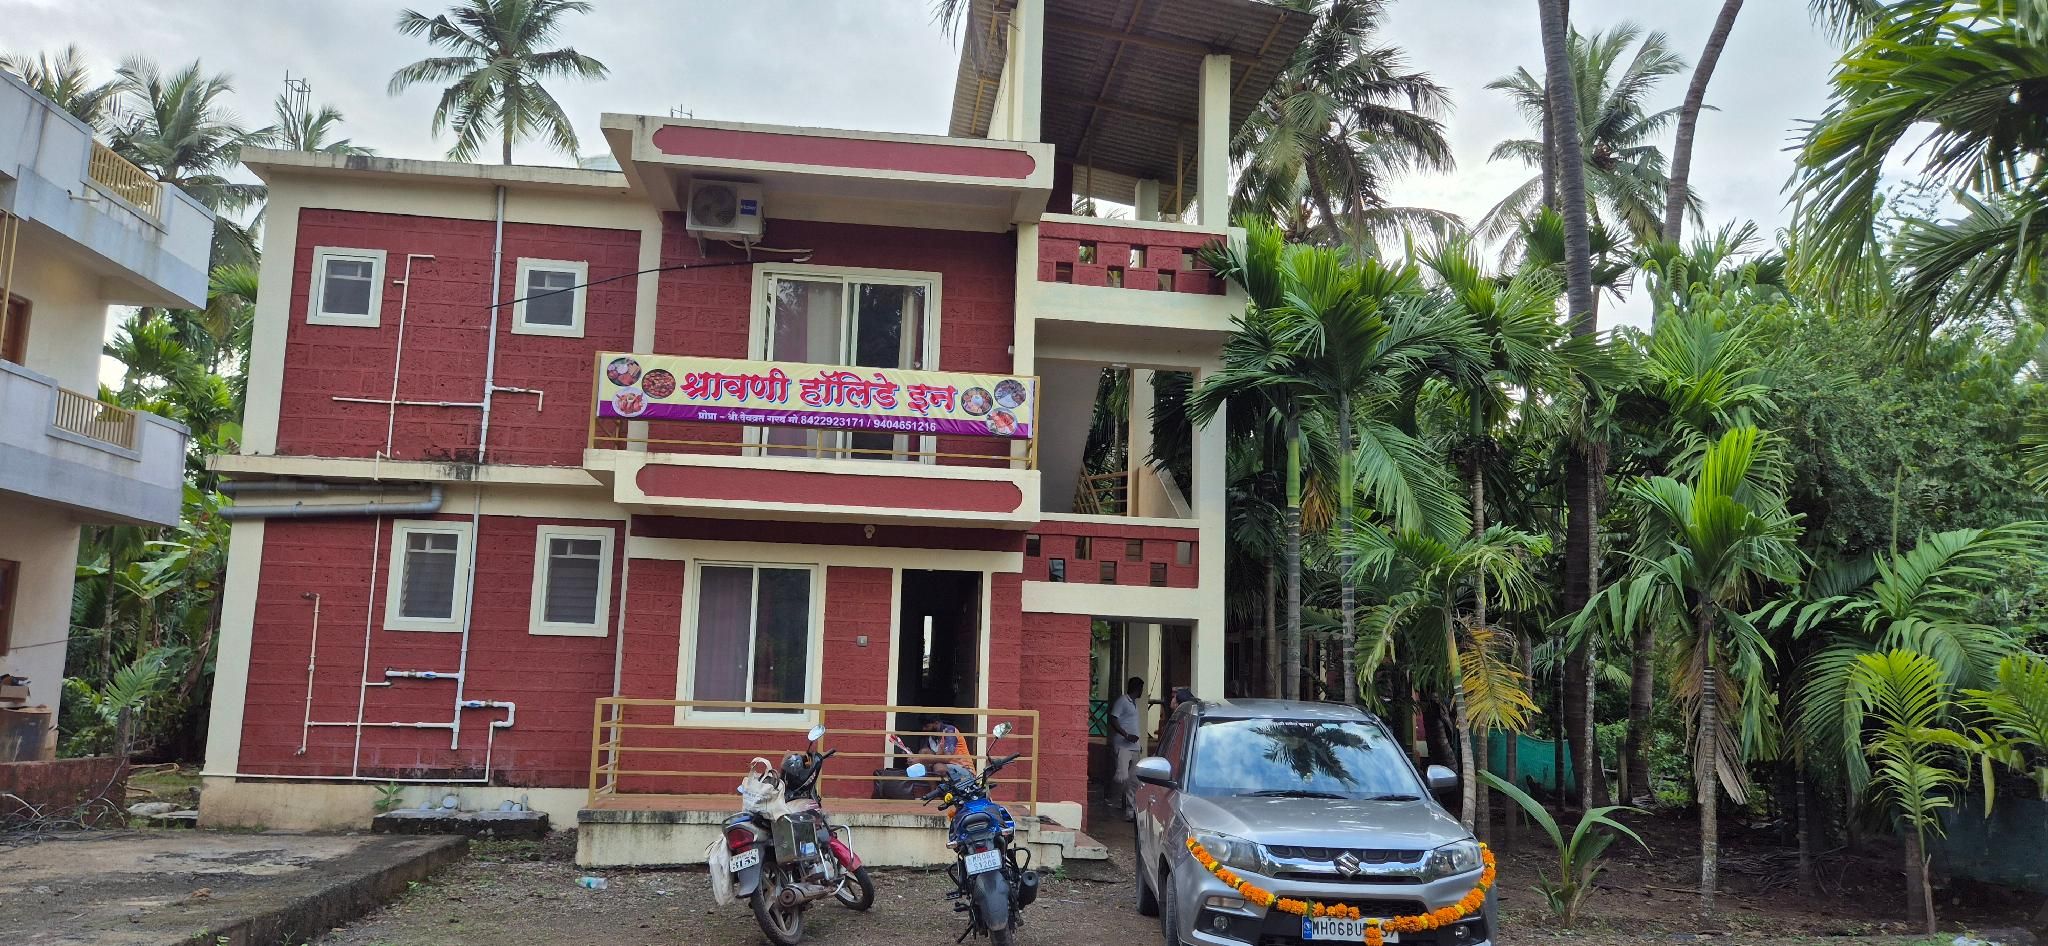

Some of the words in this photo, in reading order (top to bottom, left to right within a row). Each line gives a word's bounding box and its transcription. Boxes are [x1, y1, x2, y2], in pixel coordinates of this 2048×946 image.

[681, 367, 792, 403] श्रावणी
[799, 370, 898, 409] हॉलिडे
[907, 383, 958, 415] इन
[873, 419, 936, 432] 9404651216
